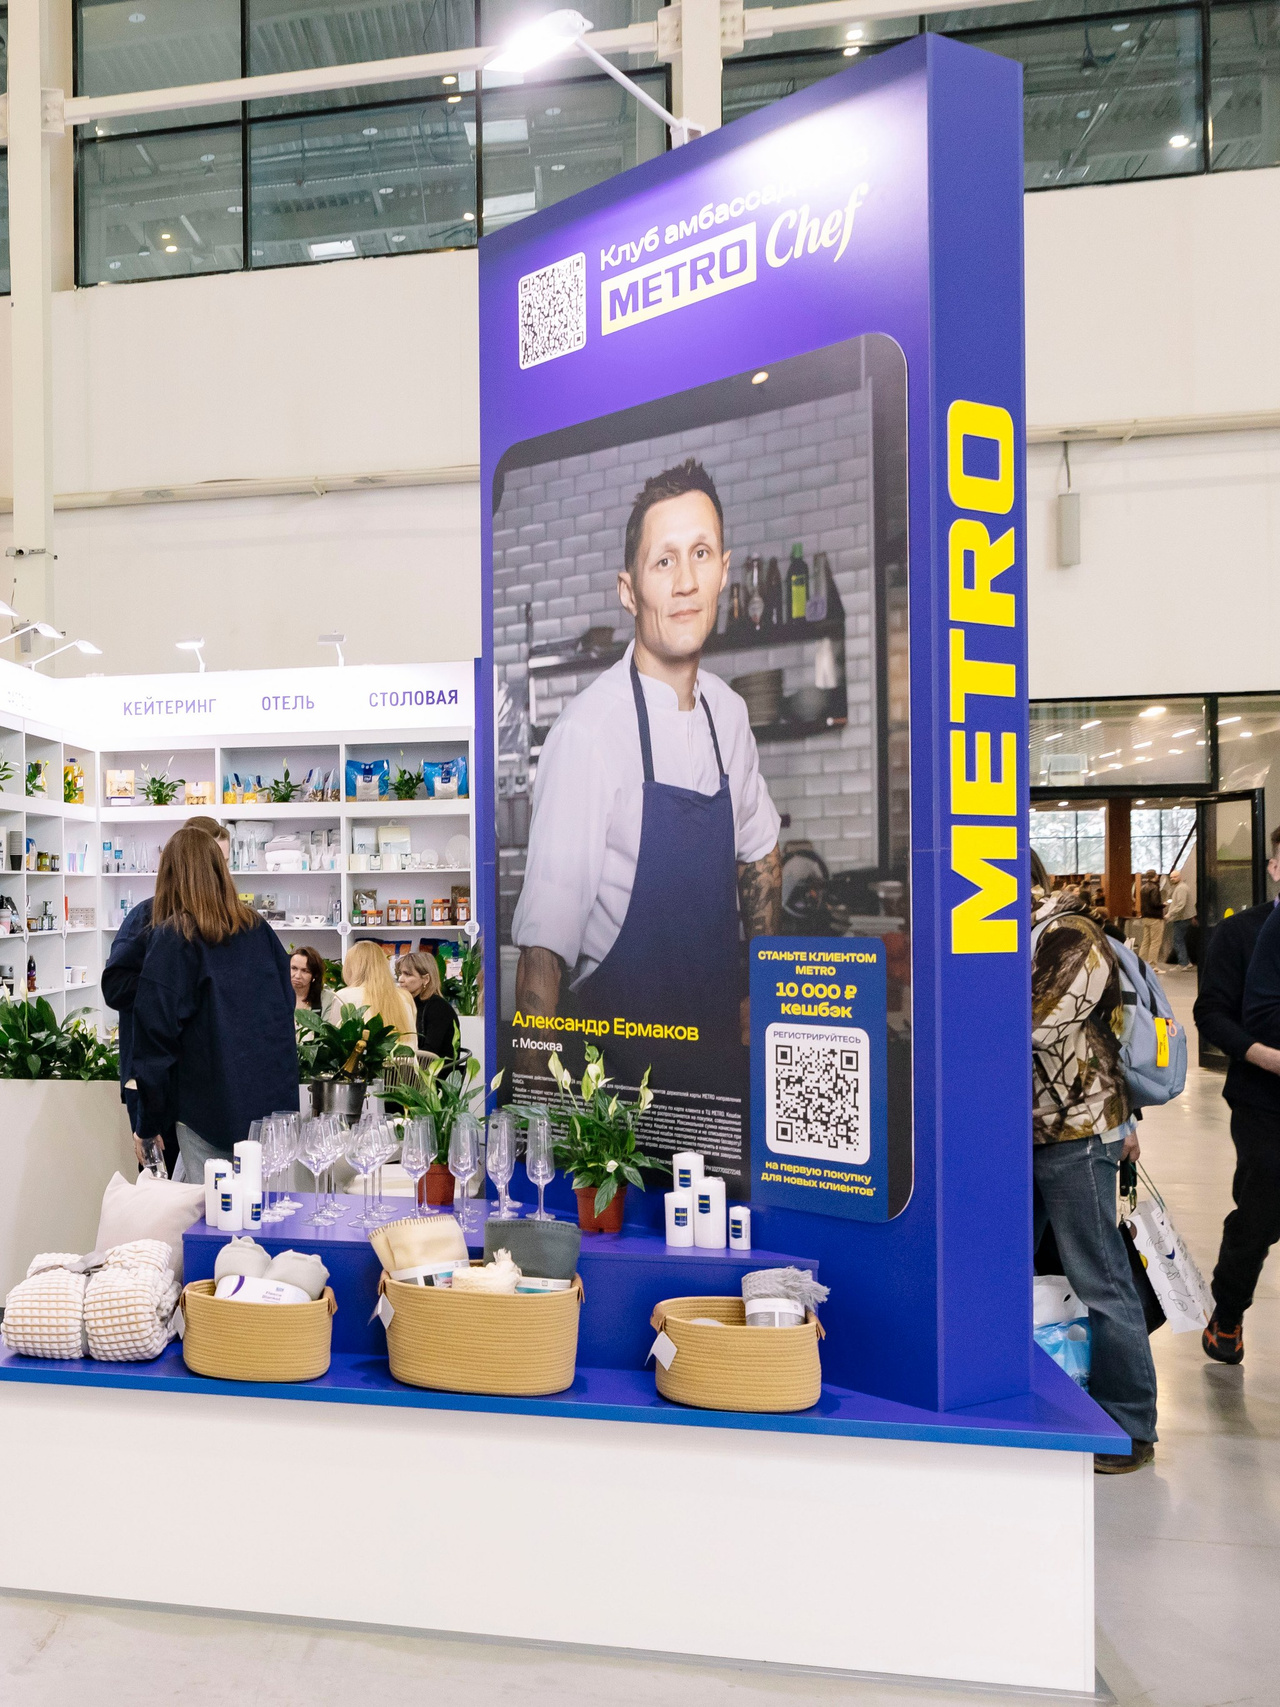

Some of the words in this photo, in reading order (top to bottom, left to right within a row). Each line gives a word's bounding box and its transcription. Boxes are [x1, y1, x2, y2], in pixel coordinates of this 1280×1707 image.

[600, 226, 660, 271] Клуб
[609, 239, 748, 321] METRO
[765, 182, 869, 269] Chef
[947, 400, 1020, 955] METRO
[123, 697, 218, 717] КЕЙТЕРИНГ
[261, 695, 316, 711] ОТЕЛЬ
[369, 689, 460, 709] СТОЛОВАЯ
[758, 949, 807, 963] СТАНЬТЕ
[809, 951, 877, 965] КЛИЕНТОМ
[795, 965, 836, 977] METRO
[776, 982, 795, 998] 10
[798, 983, 841, 1000] 000
[780, 1000, 853, 1020] кешбэк
[512, 1010, 611, 1036] Александр
[613, 1018, 700, 1042] Ермаков
[512, 1039, 519, 1051] г.
[520, 1037, 563, 1053] Москва
[773, 1028, 862, 1045] РЕГИСТРИРУЙТЕСЬ
[761, 1172, 782, 1182] для
[783, 1176, 818, 1187] новых
[765, 1161, 784, 1170] на
[780, 1163, 822, 1176] первую
[823, 1169, 872, 1186] покупку
